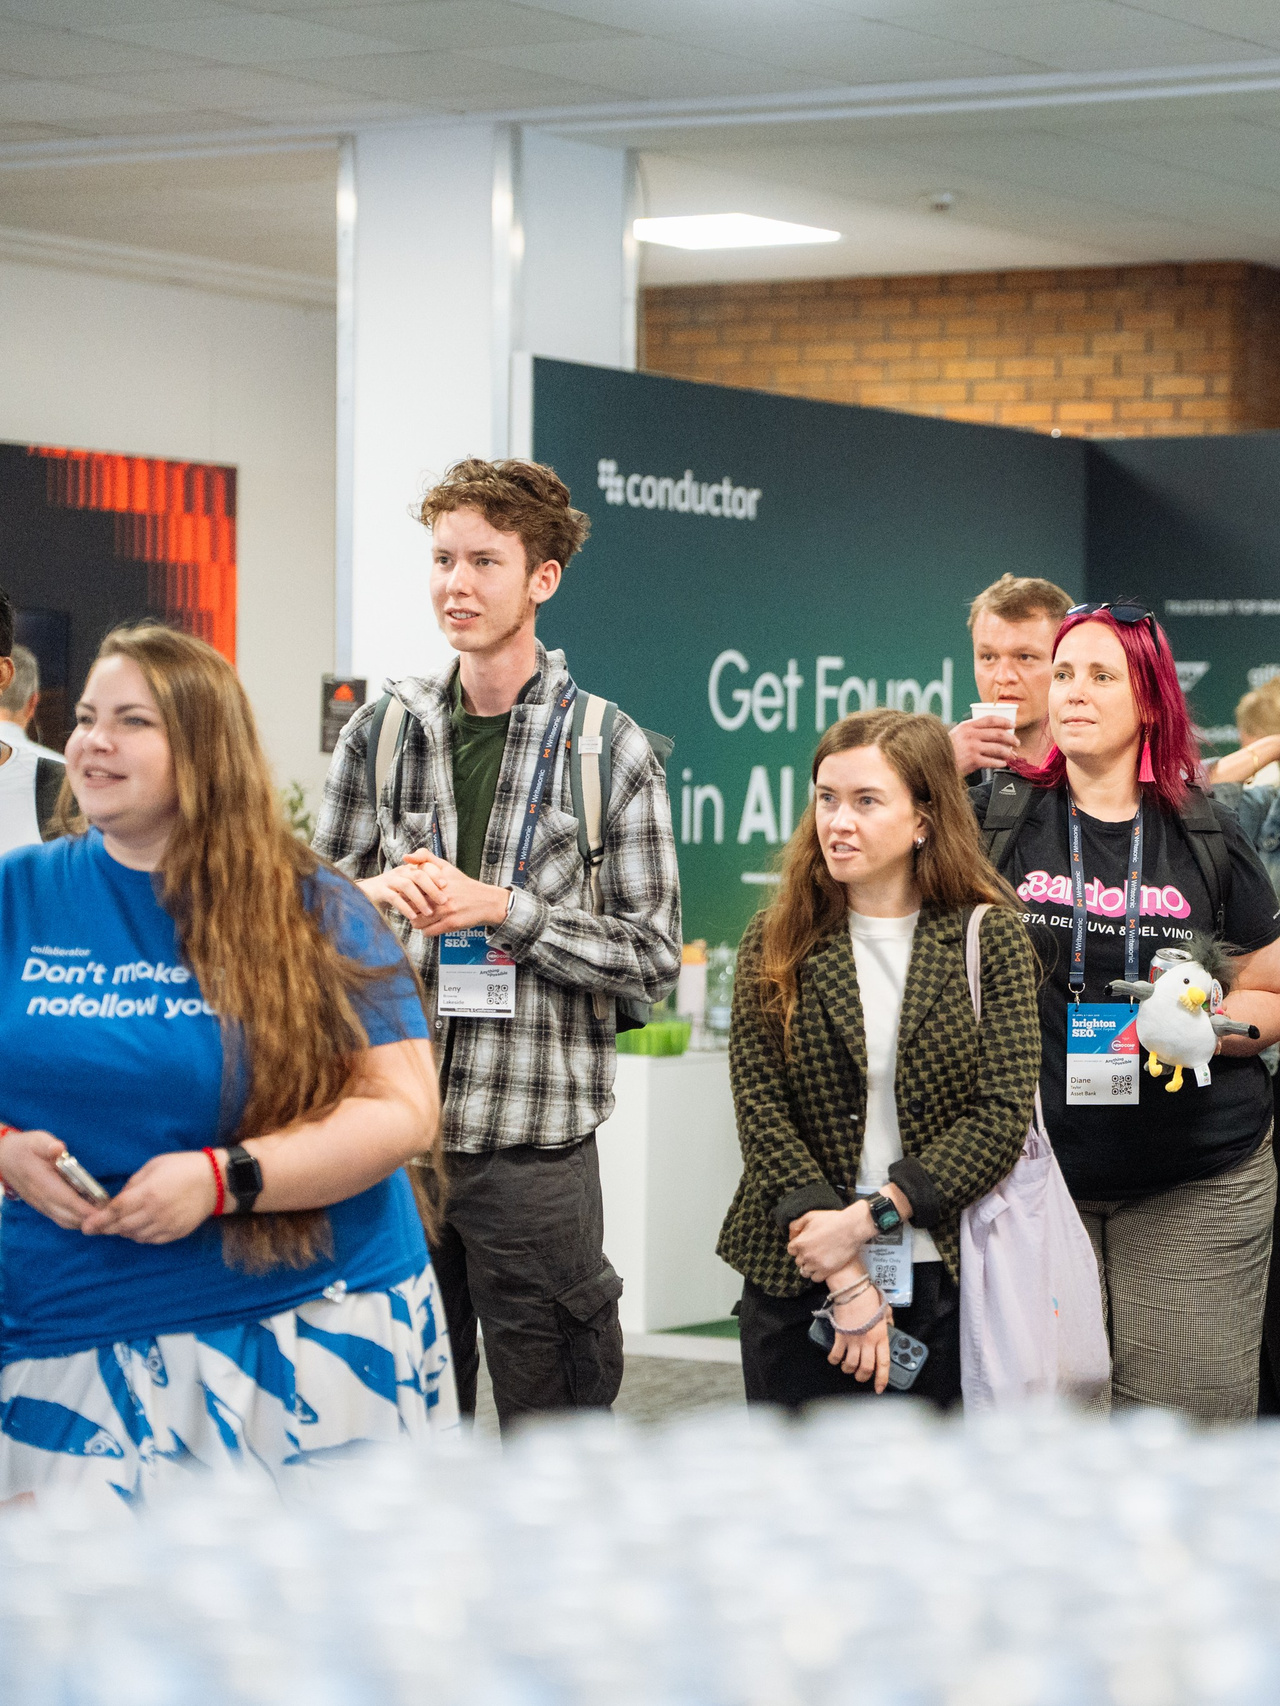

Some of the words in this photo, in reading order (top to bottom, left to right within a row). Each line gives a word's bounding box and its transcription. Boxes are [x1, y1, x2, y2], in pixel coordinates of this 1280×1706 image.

[626, 468, 763, 521] conductor
[708, 649, 804, 733] Get
[815, 656, 953, 733] Found
[546, 715, 561, 748] Writesonic
[531, 769, 546, 803] Writesonic
[681, 767, 725, 845] in
[737, 765, 794, 845] AI
[520, 825, 533, 860] Writesonic
[1130, 880, 1138, 908] Writesonic
[444, 928, 486, 938] brighto
[444, 938, 471, 948] SEO.
[1075, 917, 1084, 952] Writesonic
[1128, 930, 1136, 964] Writesonic
[1162, 926, 1194, 940] VINO
[30, 944, 91, 957] collaborator
[21, 957, 108, 985] Don't
[111, 960, 191, 985] make
[444, 985, 462, 993] Leny
[26, 992, 158, 1019] nofollow
[1072, 1018, 1116, 1028] brighton
[1072, 1028, 1096, 1038] SEO.
